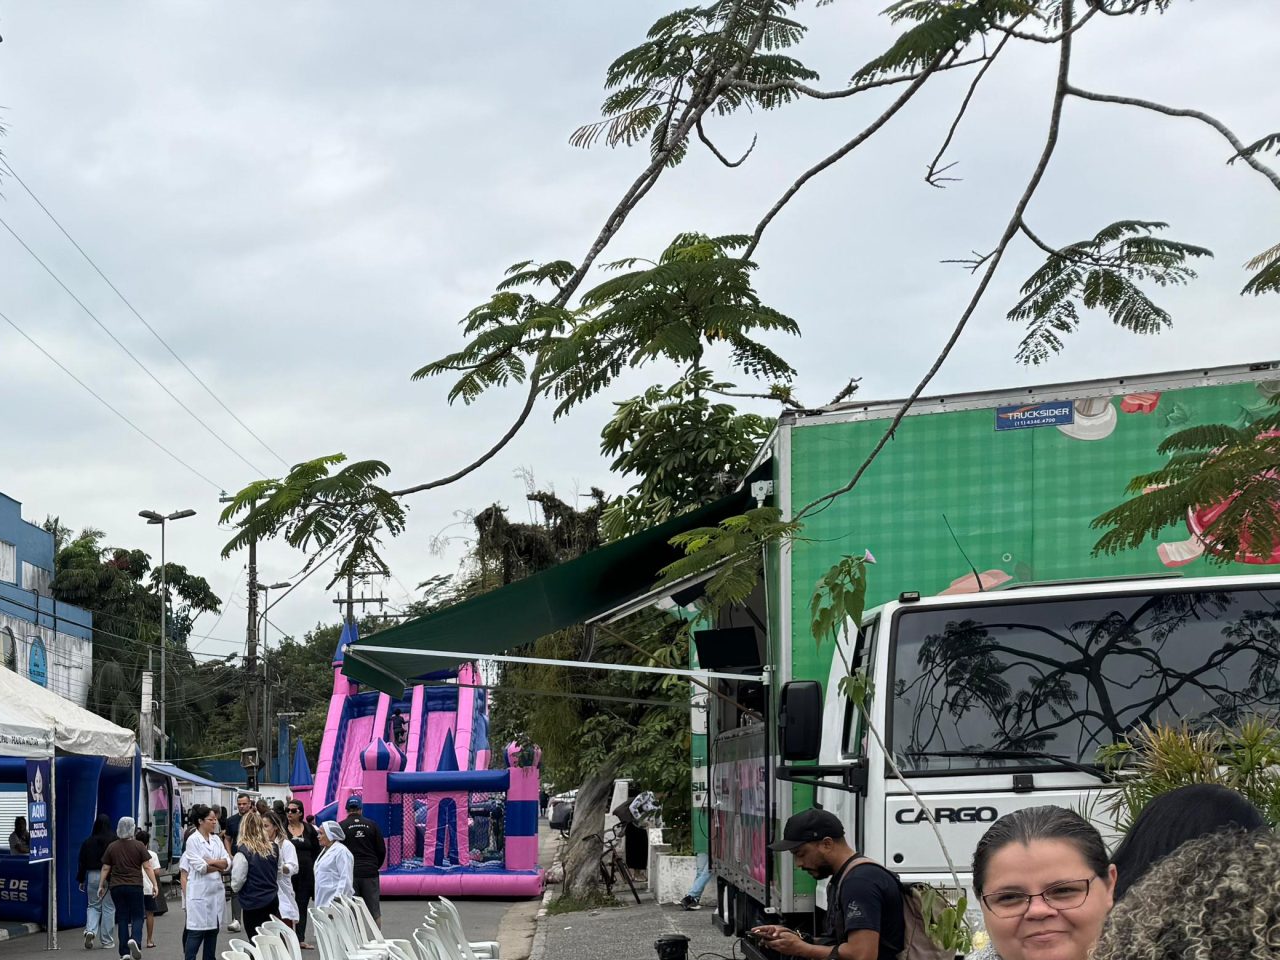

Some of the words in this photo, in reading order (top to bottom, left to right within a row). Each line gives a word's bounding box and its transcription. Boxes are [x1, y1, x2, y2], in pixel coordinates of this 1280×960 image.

[1007, 407, 1070, 420] TRUCKSIDER
[31, 804, 45, 819] AQUI
[894, 806, 999, 825] CARGO
[9, 879, 29, 891] DE
